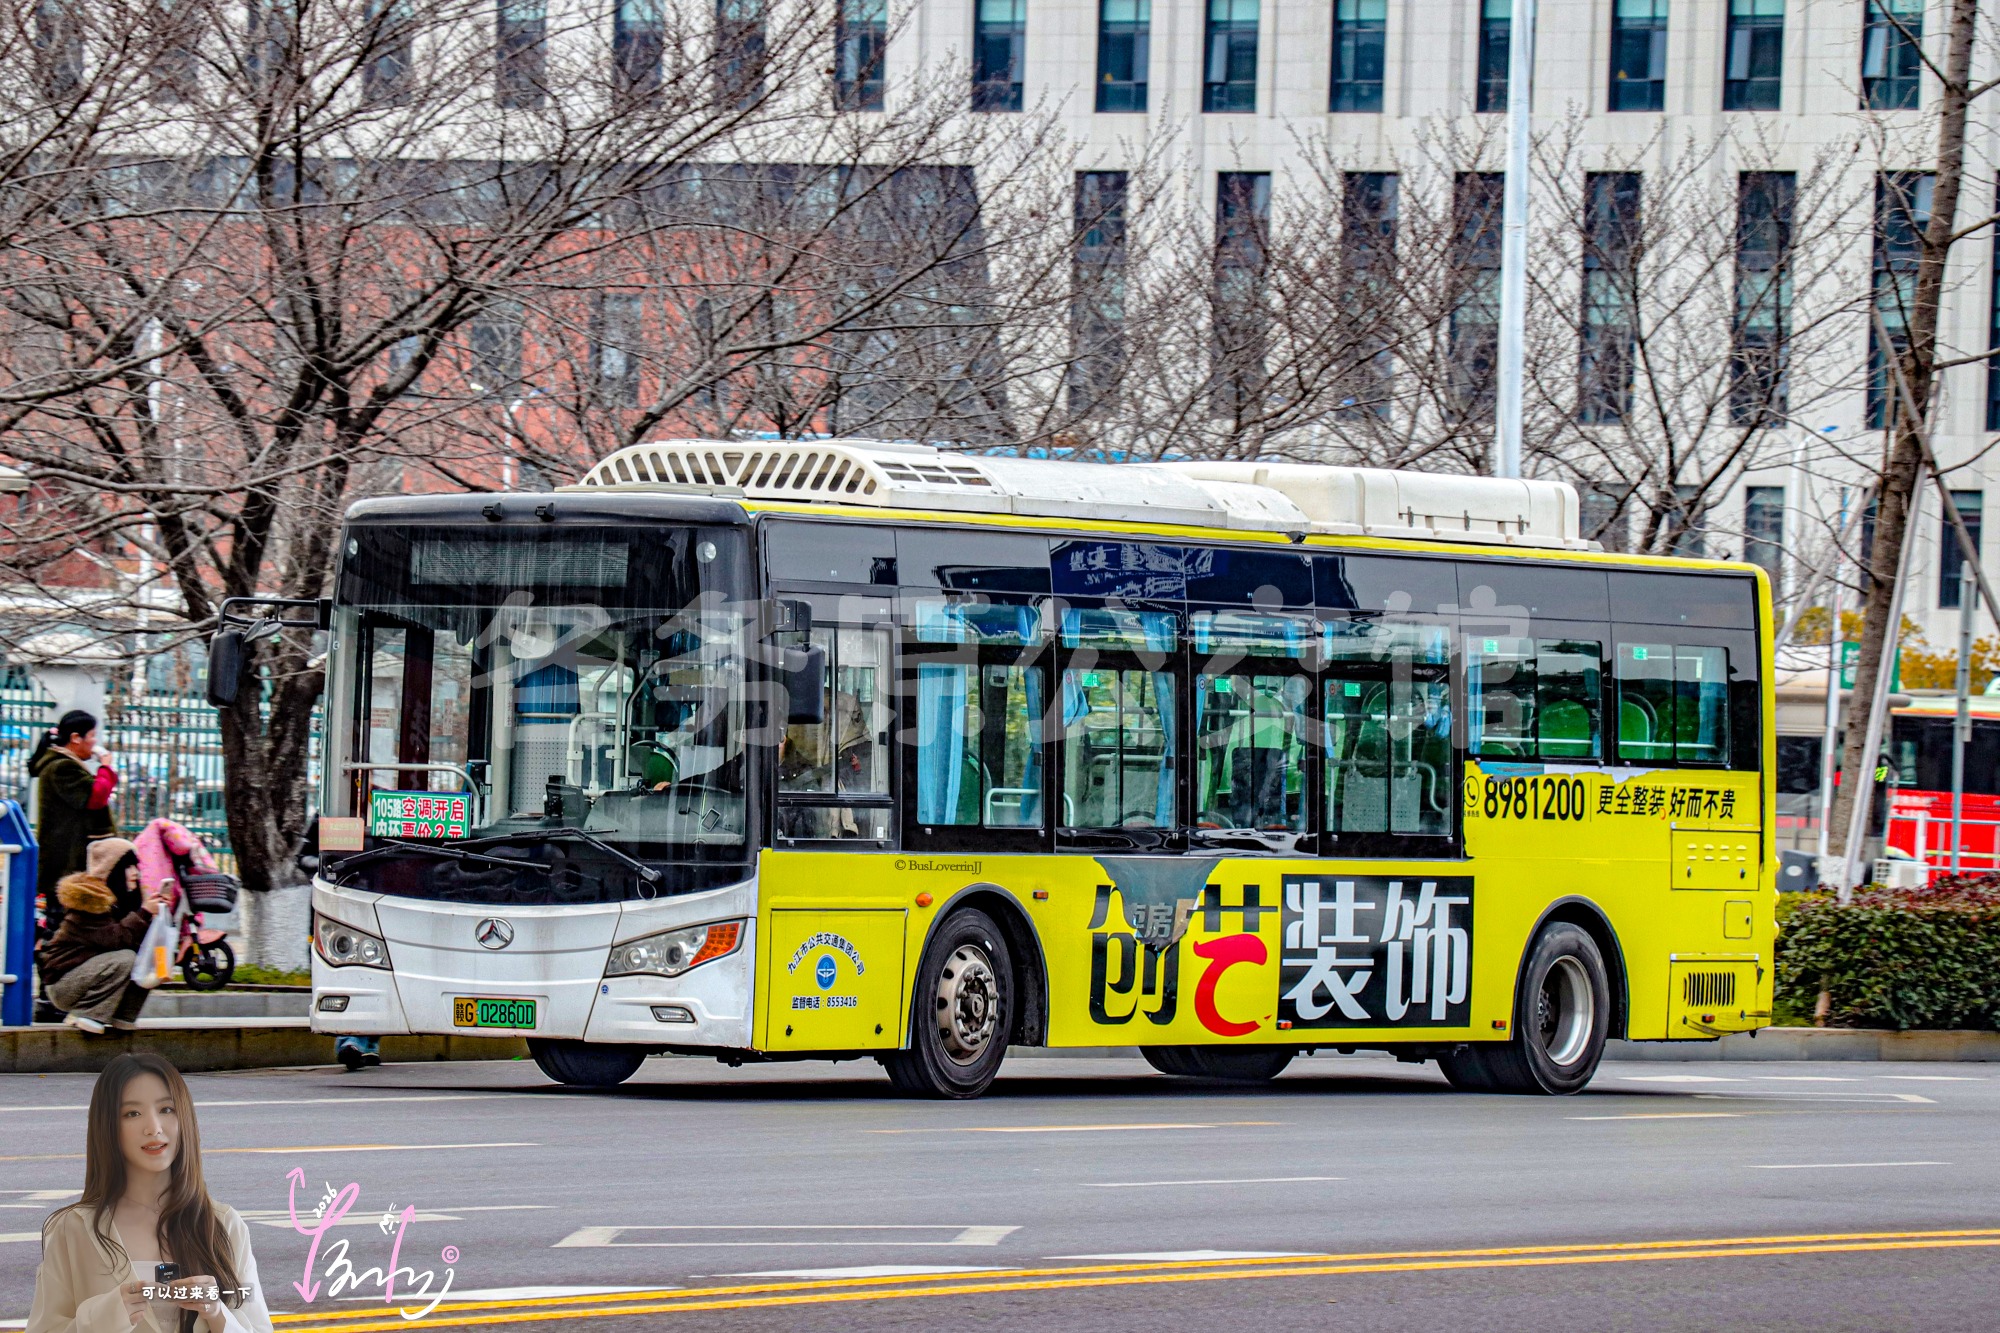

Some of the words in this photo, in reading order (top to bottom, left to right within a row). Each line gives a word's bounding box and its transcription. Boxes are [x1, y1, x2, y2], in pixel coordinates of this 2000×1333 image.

[1484, 777, 1585, 821] 8981200
[1669, 786, 1736, 819] 好而不贵
